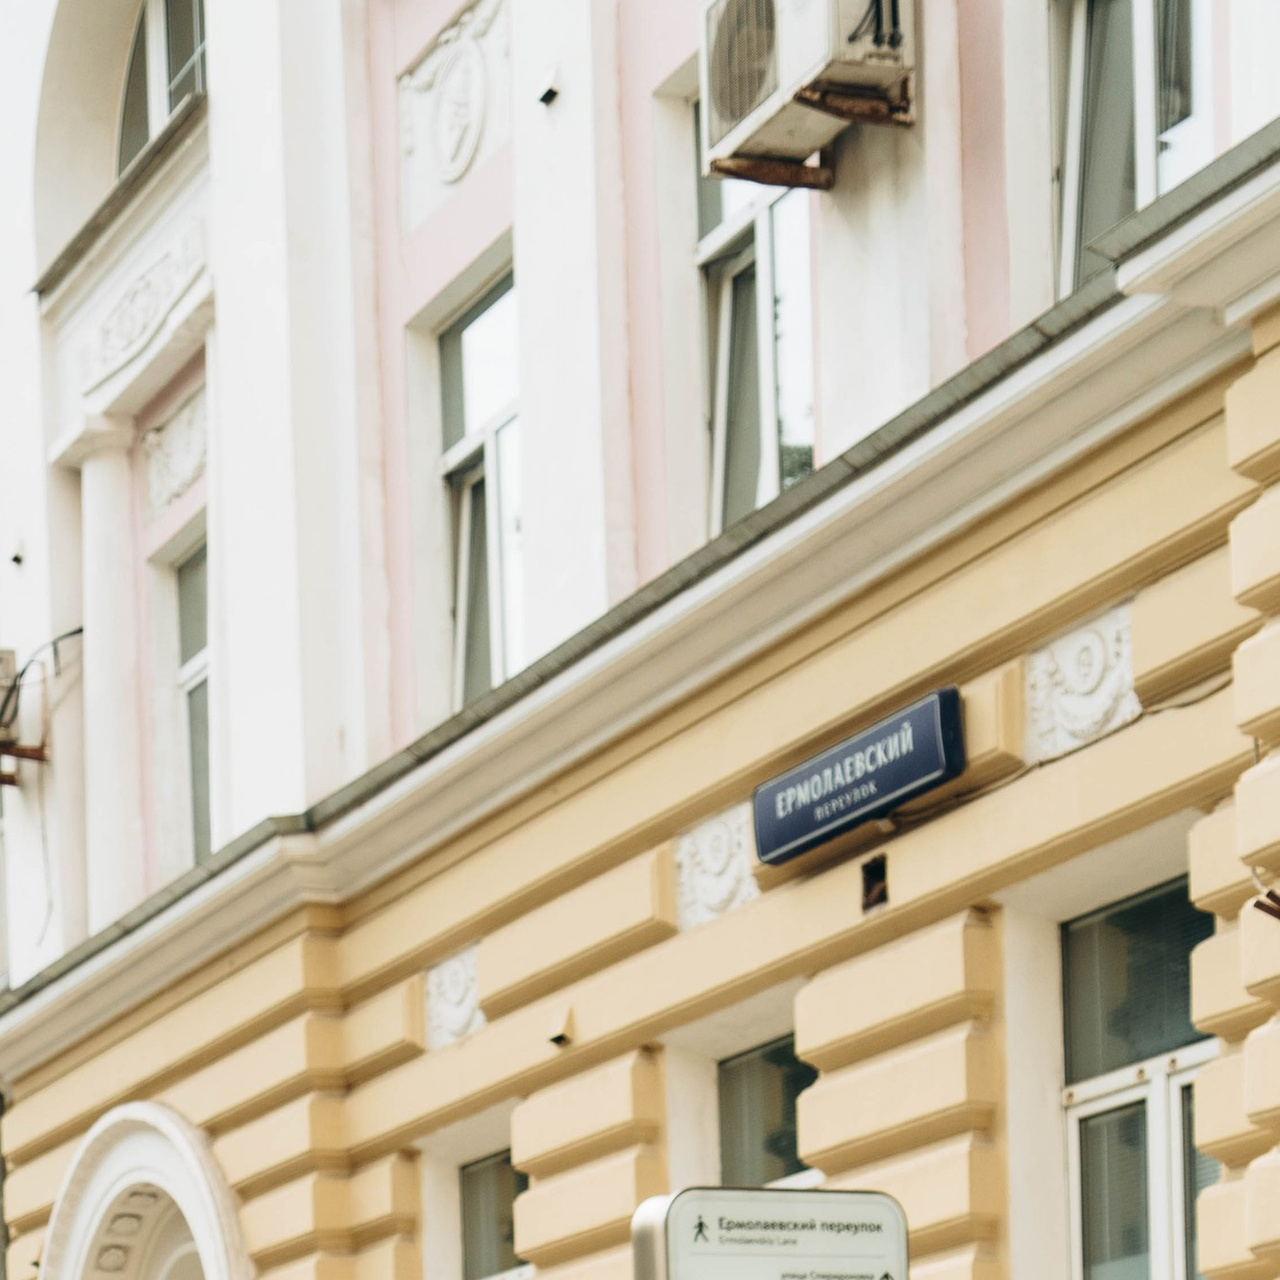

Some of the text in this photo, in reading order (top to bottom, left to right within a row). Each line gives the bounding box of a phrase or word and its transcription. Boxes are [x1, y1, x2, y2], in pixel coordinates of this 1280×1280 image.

[775, 720, 914, 819] ЕРМОЛАЕВСКИЙ
[814, 780, 878, 821] ПЕРЕУЛОК
[718, 1217, 883, 1235] Ермолаевский переулок
